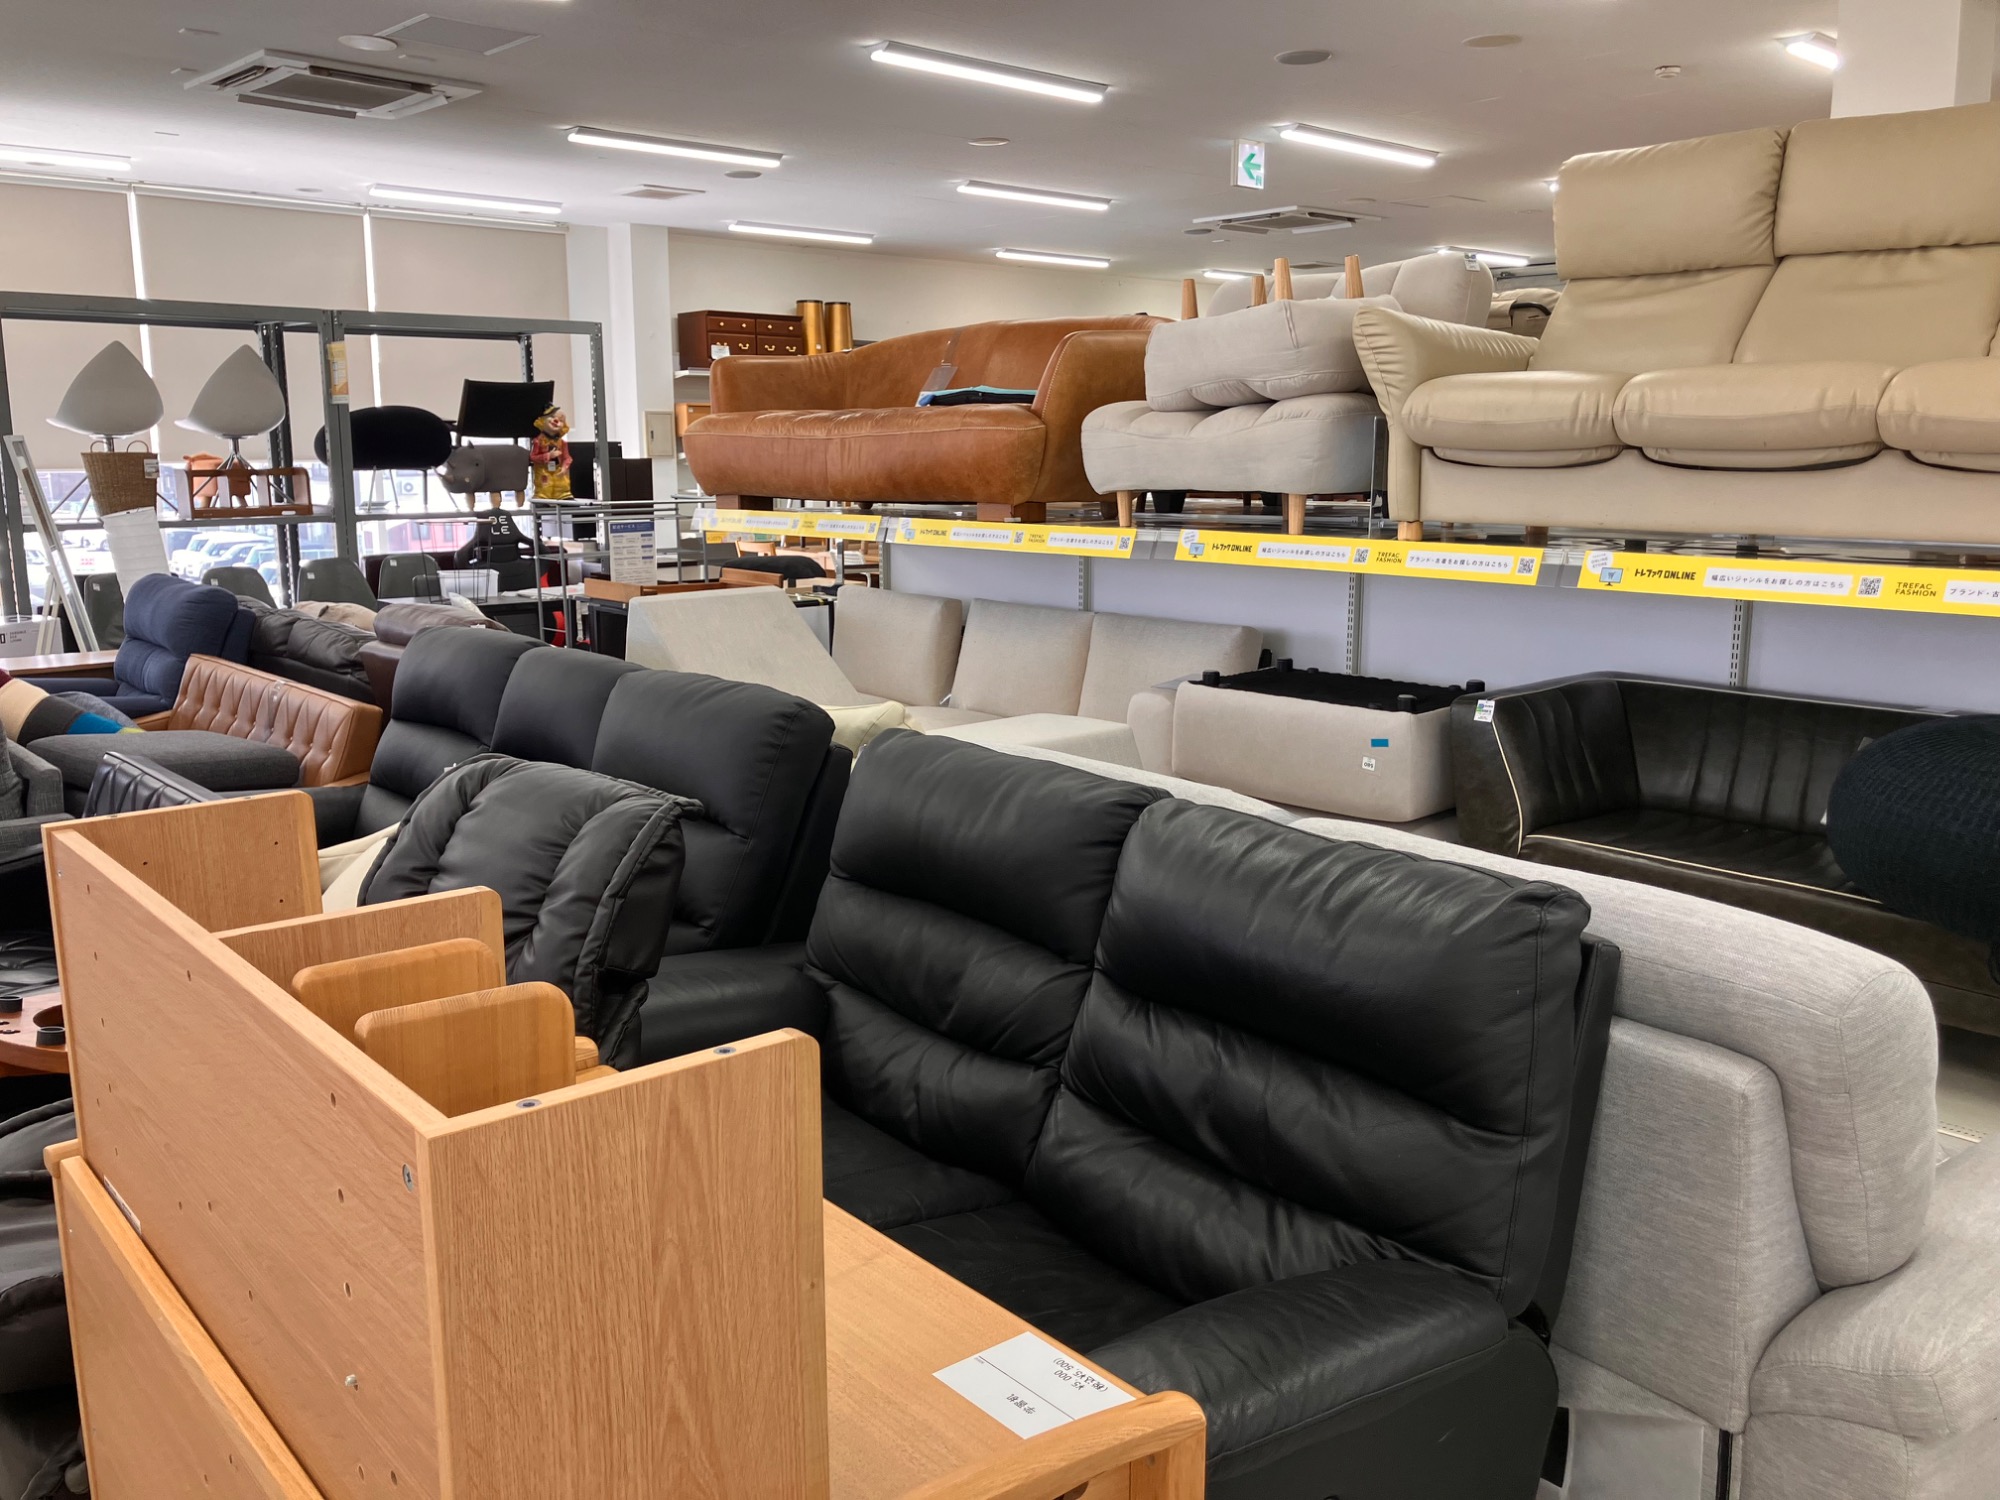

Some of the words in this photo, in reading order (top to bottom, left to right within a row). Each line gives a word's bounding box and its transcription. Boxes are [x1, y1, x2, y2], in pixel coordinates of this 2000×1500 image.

[491, 525, 510, 535] LE
[1377, 551, 1400, 559] TREFAC
[1897, 581, 1933, 590] TREFAC
[1895, 588, 1937, 597] FASHION
[1006, 1393, 1036, 1415] 学習机
